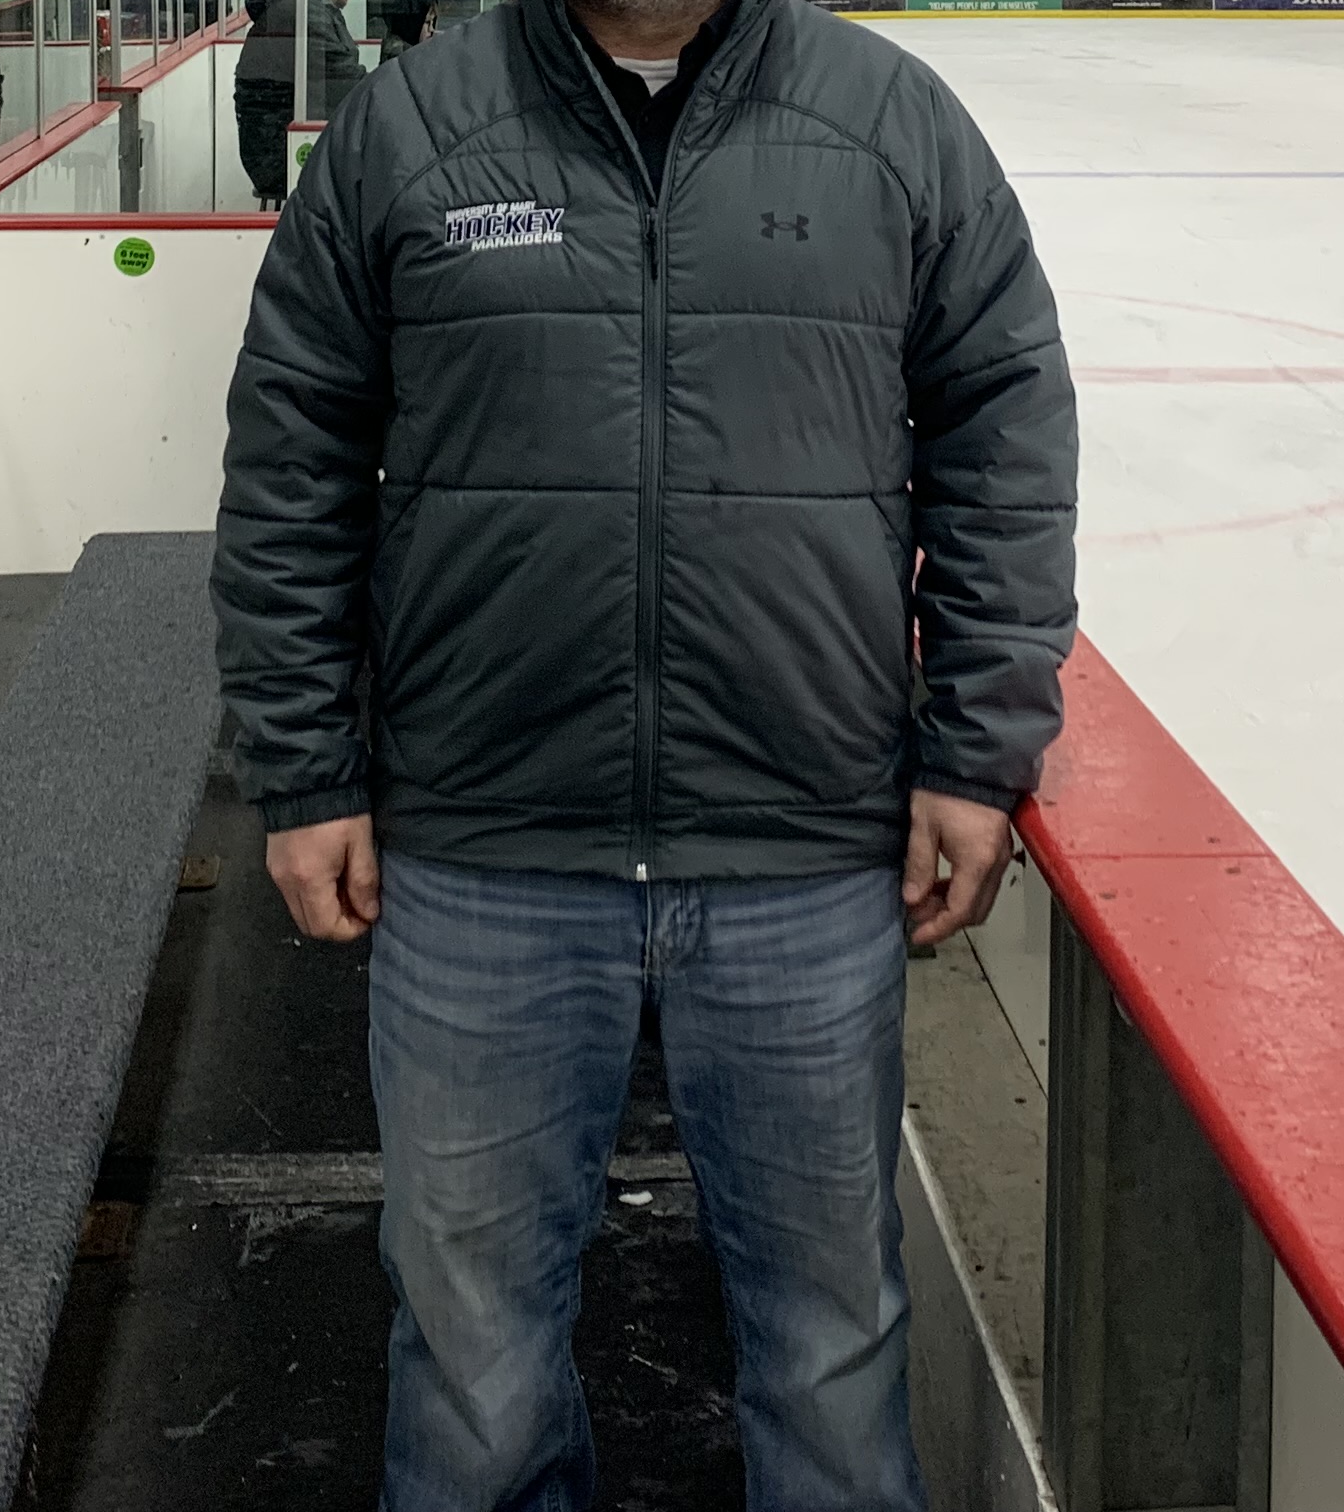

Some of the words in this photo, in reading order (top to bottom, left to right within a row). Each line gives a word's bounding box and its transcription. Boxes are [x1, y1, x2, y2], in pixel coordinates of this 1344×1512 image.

[446, 202, 495, 222] UNIVERSITY
[496, 202, 509, 213] OF
[510, 200, 536, 212] MARY
[445, 208, 565, 246] HOCKEY
[471, 231, 563, 252] MARAUDERS
[120, 259, 148, 269] away
[129, 249, 150, 260] feet
